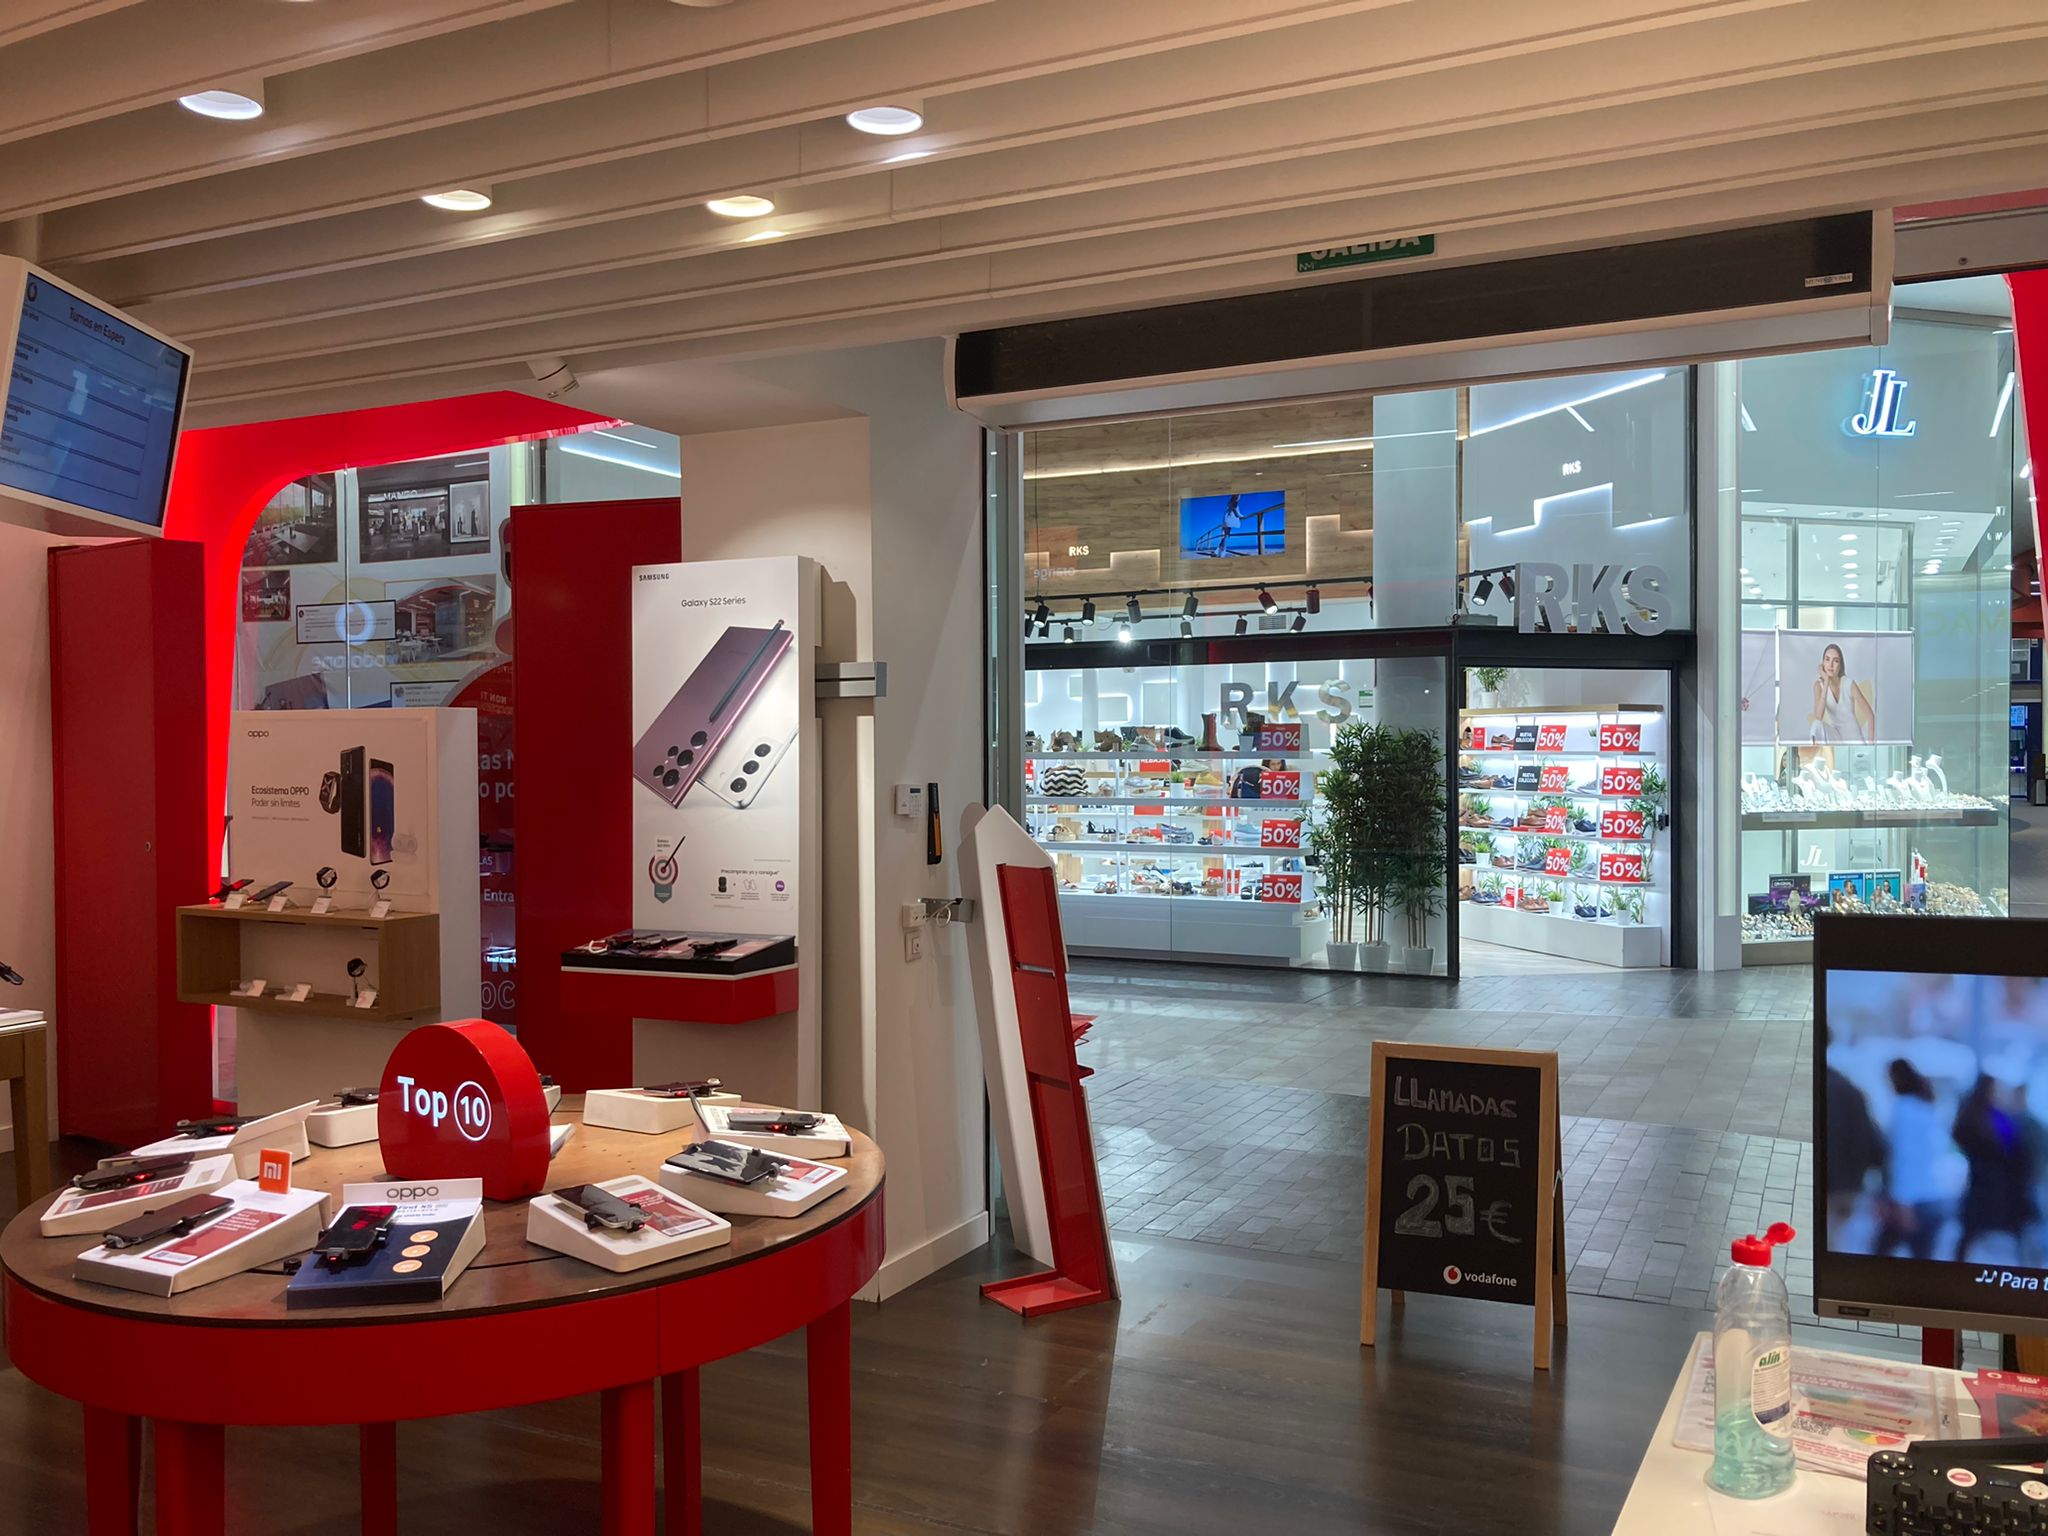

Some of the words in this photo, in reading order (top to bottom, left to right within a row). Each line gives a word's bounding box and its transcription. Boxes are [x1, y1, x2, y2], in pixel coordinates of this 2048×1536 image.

[103, 325, 126, 345] Espera
[1850, 369, 1916, 437] JL
[1562, 460, 1582, 476] RKS
[1068, 545, 1090, 557] RKS
[639, 573, 670, 581] SAMSUNG
[681, 599, 708, 608] Galaxy
[709, 598, 722, 606] S22
[723, 597, 746, 605] Series
[1514, 562, 1672, 637] RKS
[1220, 679, 1351, 726] RKS
[248, 730, 270, 738] oppo
[1261, 731, 1300, 747] 50%
[1539, 732, 1565, 747] 50%
[1601, 732, 1640, 747] 50%
[1261, 779, 1300, 795] 50%
[1540, 774, 1566, 788] 50%
[1603, 776, 1641, 791] 50%
[251, 785, 289, 795] Ecosistema
[290, 786, 310, 796] OPPO
[251, 797, 269, 807] Poder
[270, 798, 280, 807] sin
[1545, 814, 1566, 830] 50%
[1603, 819, 1641, 834] 50%
[1262, 827, 1300, 844] 50%
[1545, 856, 1569, 871] 50%
[1800, 845, 1827, 867] JL
[1601, 862, 1640, 877] 50%
[1262, 882, 1301, 899] 50%
[397, 1075, 448, 1128] Top
[460, 1096, 486, 1127] 10
[1393, 1075, 1518, 1119] LLAMADAS
[1397, 1123, 1521, 1168] DATOS
[387, 1186, 439, 1200] oppo
[1464, 1272, 1518, 1287] vodafone
[1999, 1271, 2039, 1290] Para
